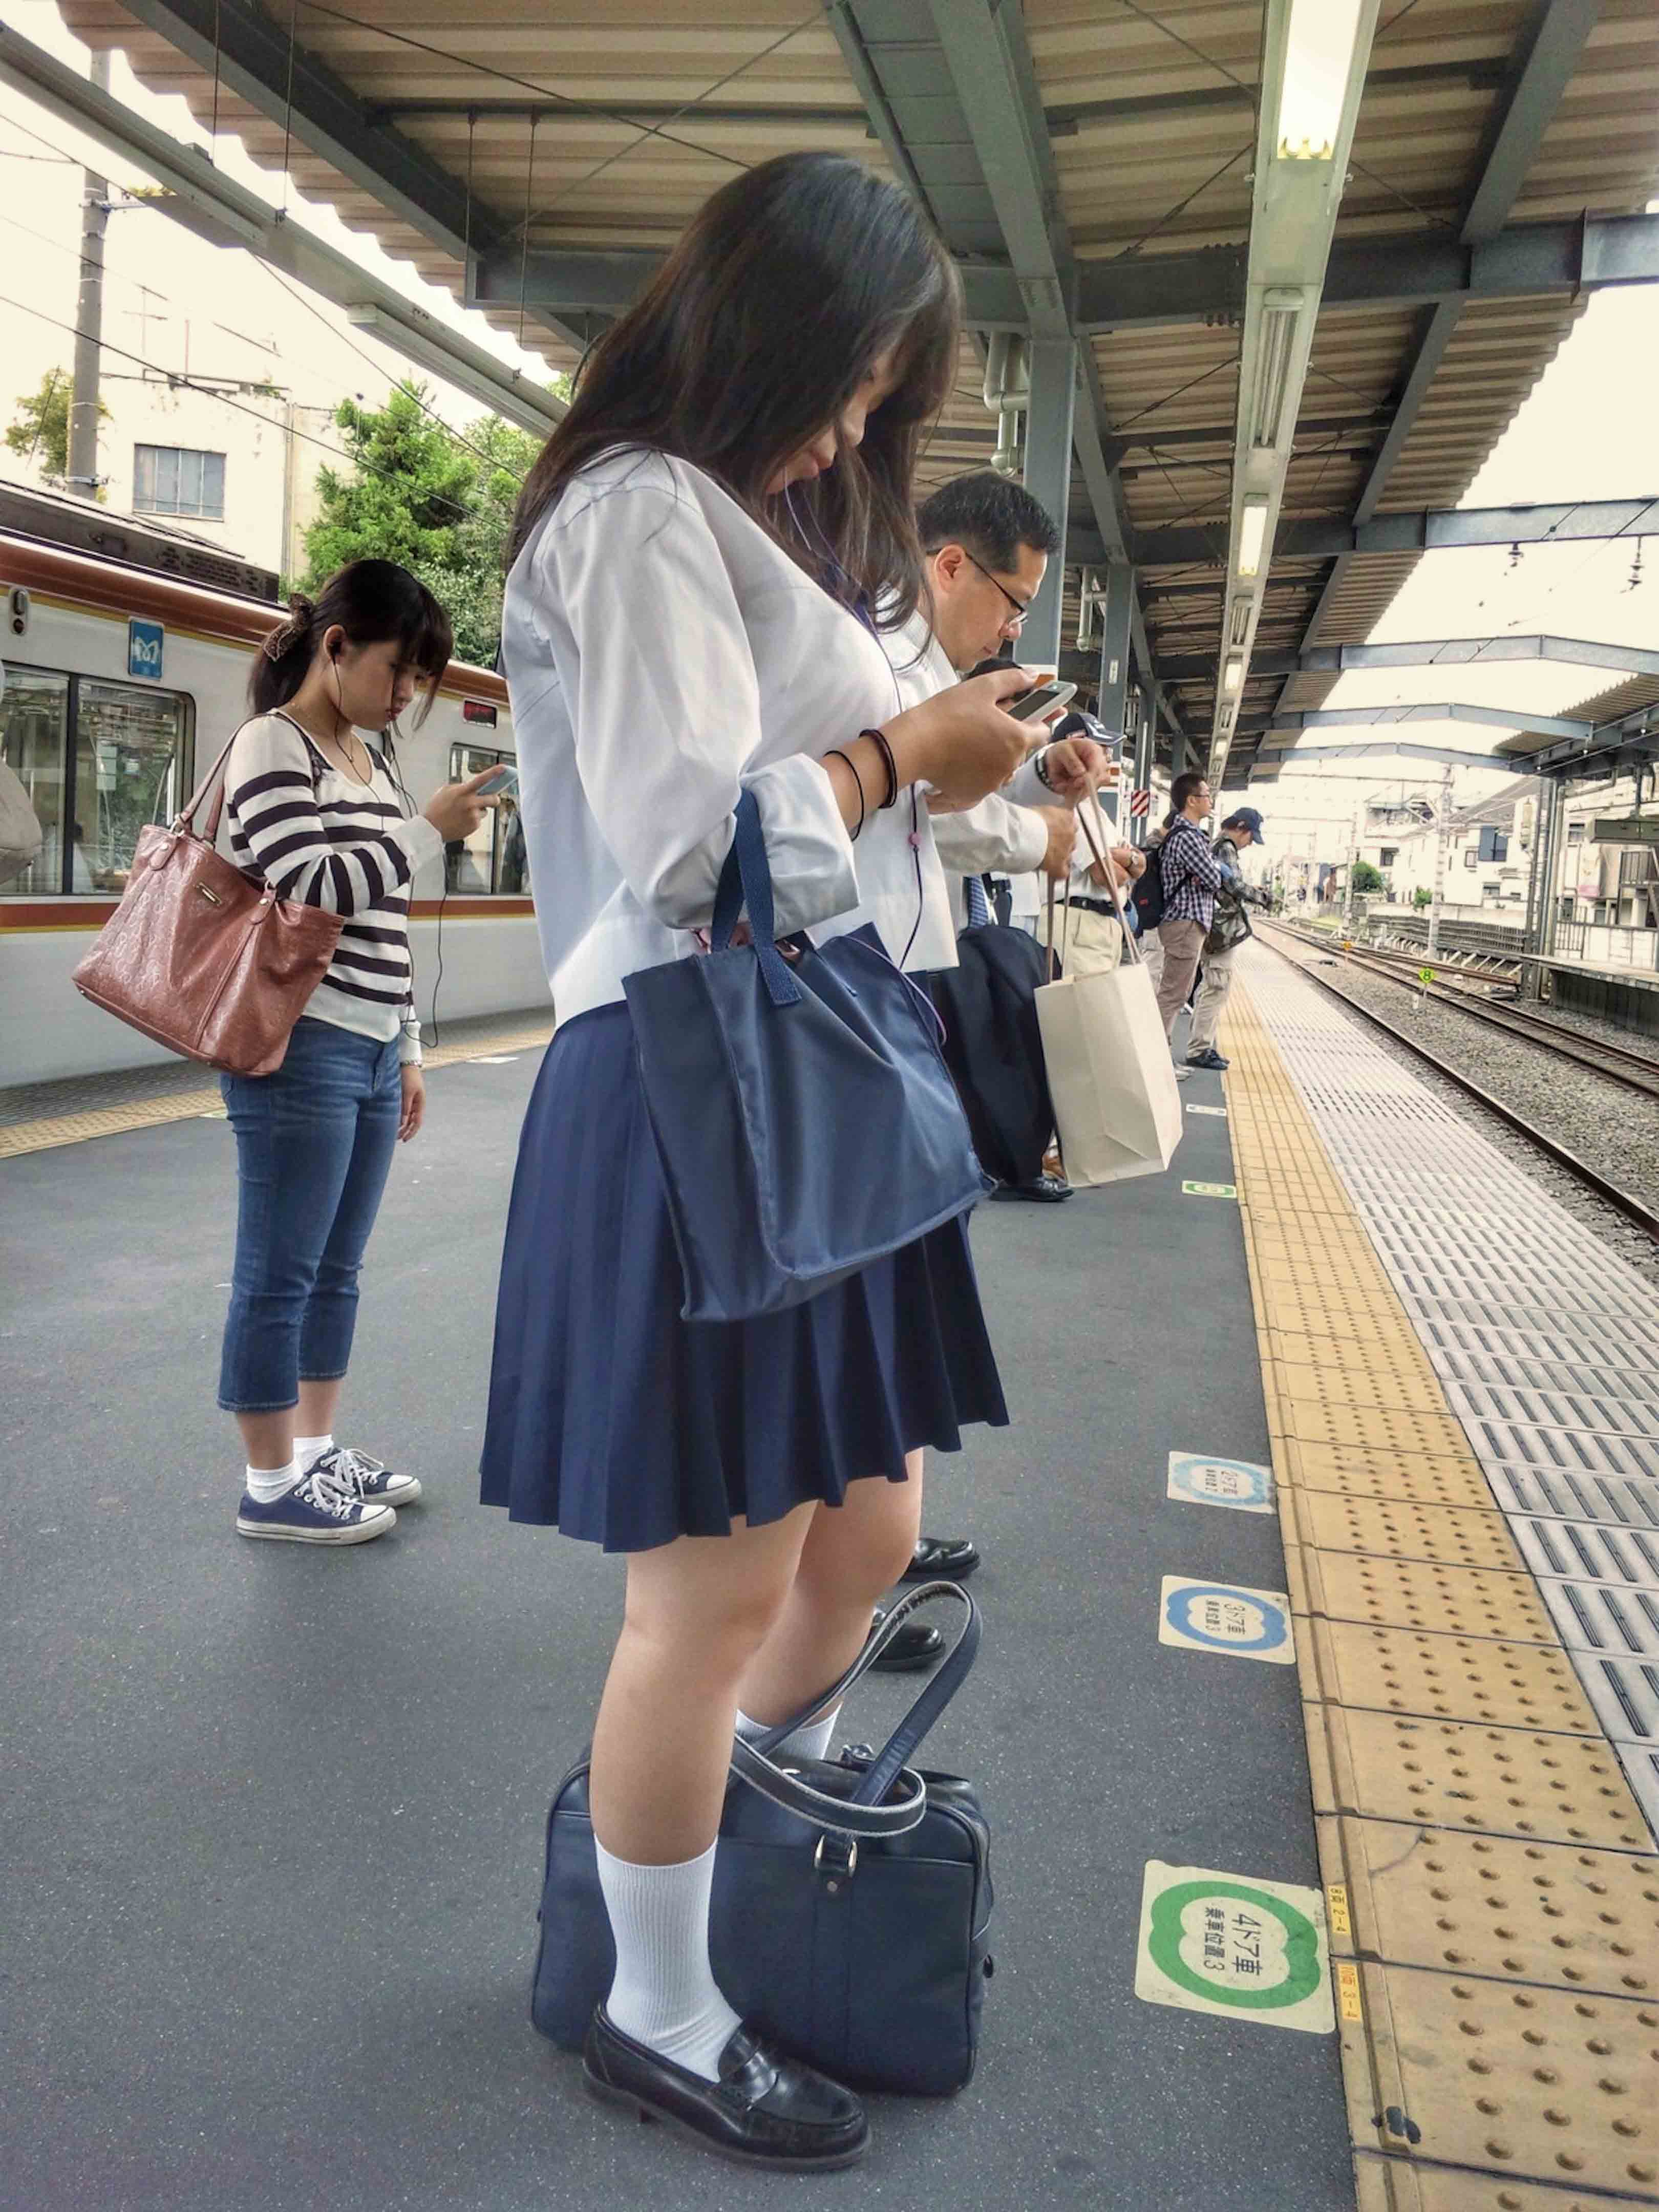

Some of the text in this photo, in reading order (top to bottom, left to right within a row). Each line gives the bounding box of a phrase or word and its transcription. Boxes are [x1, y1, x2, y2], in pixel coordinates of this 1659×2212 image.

[1424, 971, 1430, 980] 8
[1224, 1604, 1245, 1634] 3ドア車
[1204, 1907, 1224, 1971] 乗車位置3
[1232, 1913, 1263, 1975] 4ドア車
